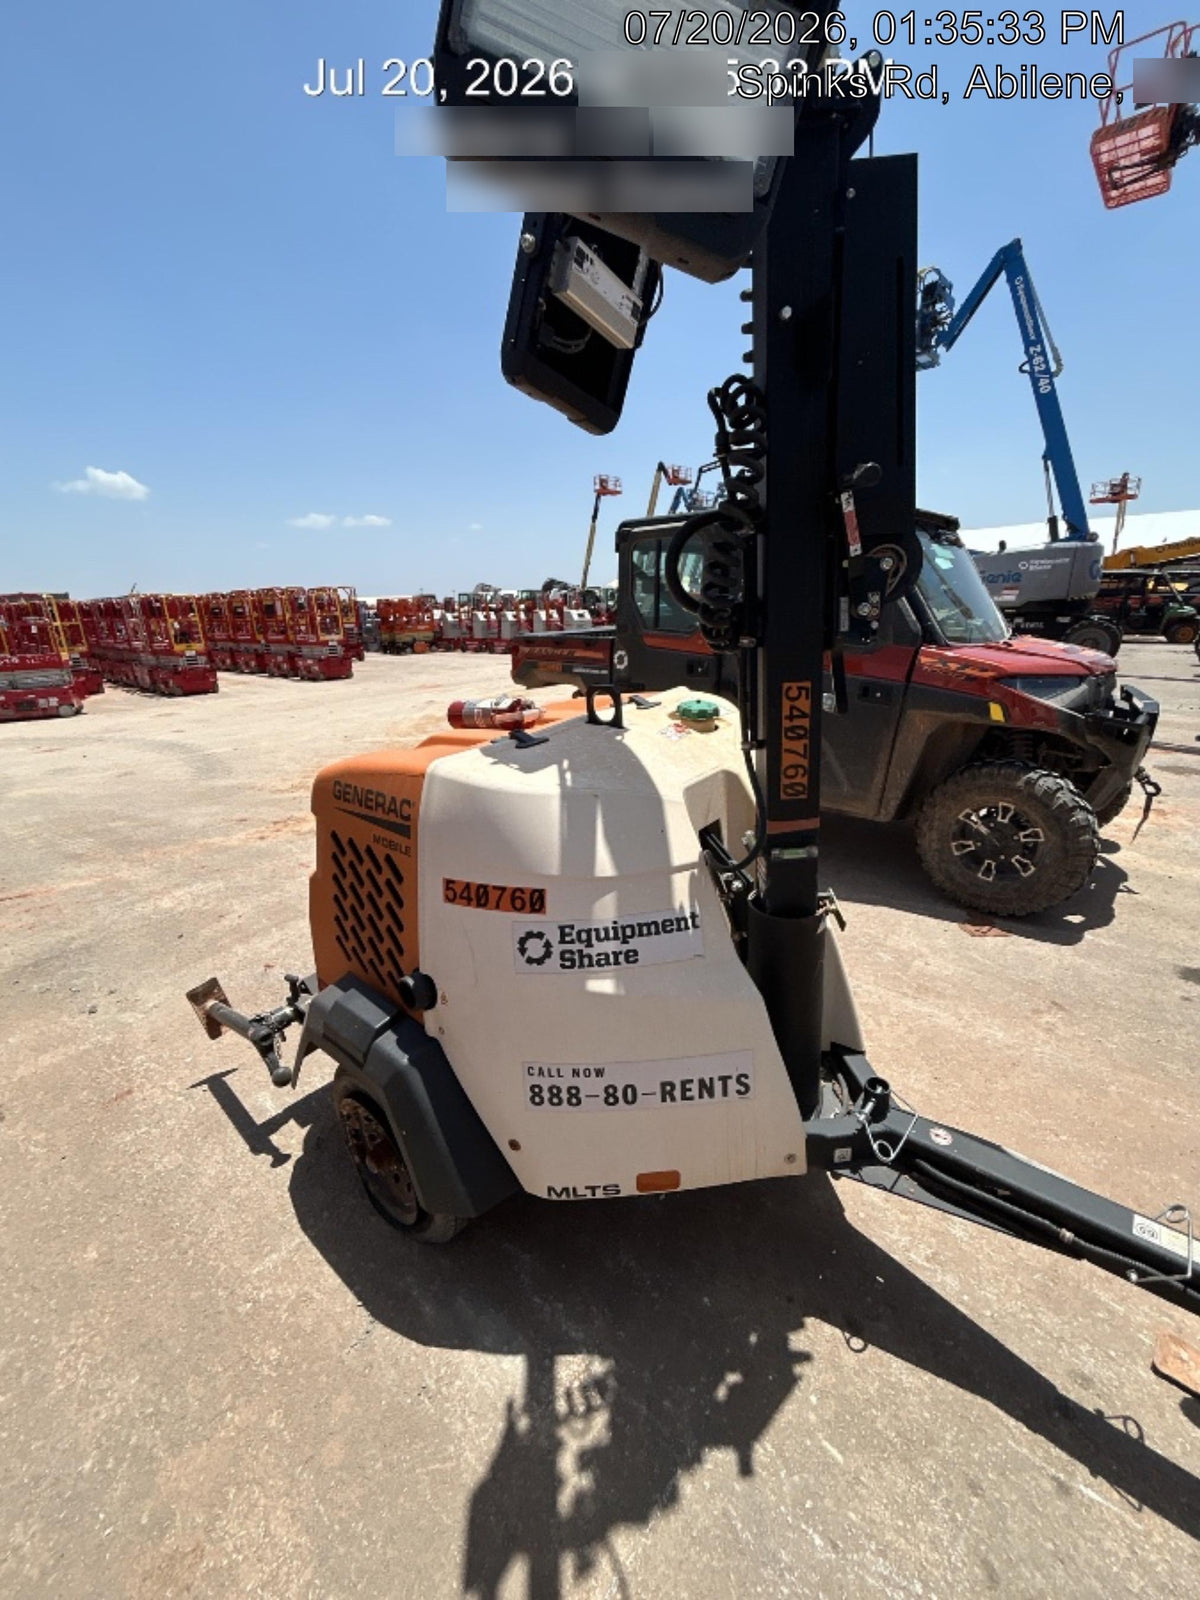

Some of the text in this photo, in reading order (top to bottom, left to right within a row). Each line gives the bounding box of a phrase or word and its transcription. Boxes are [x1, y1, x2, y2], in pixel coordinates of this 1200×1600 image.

[783, 684, 811, 799] 540760
[332, 780, 412, 822] GENERAC
[372, 833, 412, 858] MOBILE
[444, 879, 546, 913] 540760
[558, 911, 701, 948] Equipment
[559, 948, 640, 970] Share
[526, 1066, 606, 1078] CALL NOW
[546, 1184, 622, 1199] MLTS
